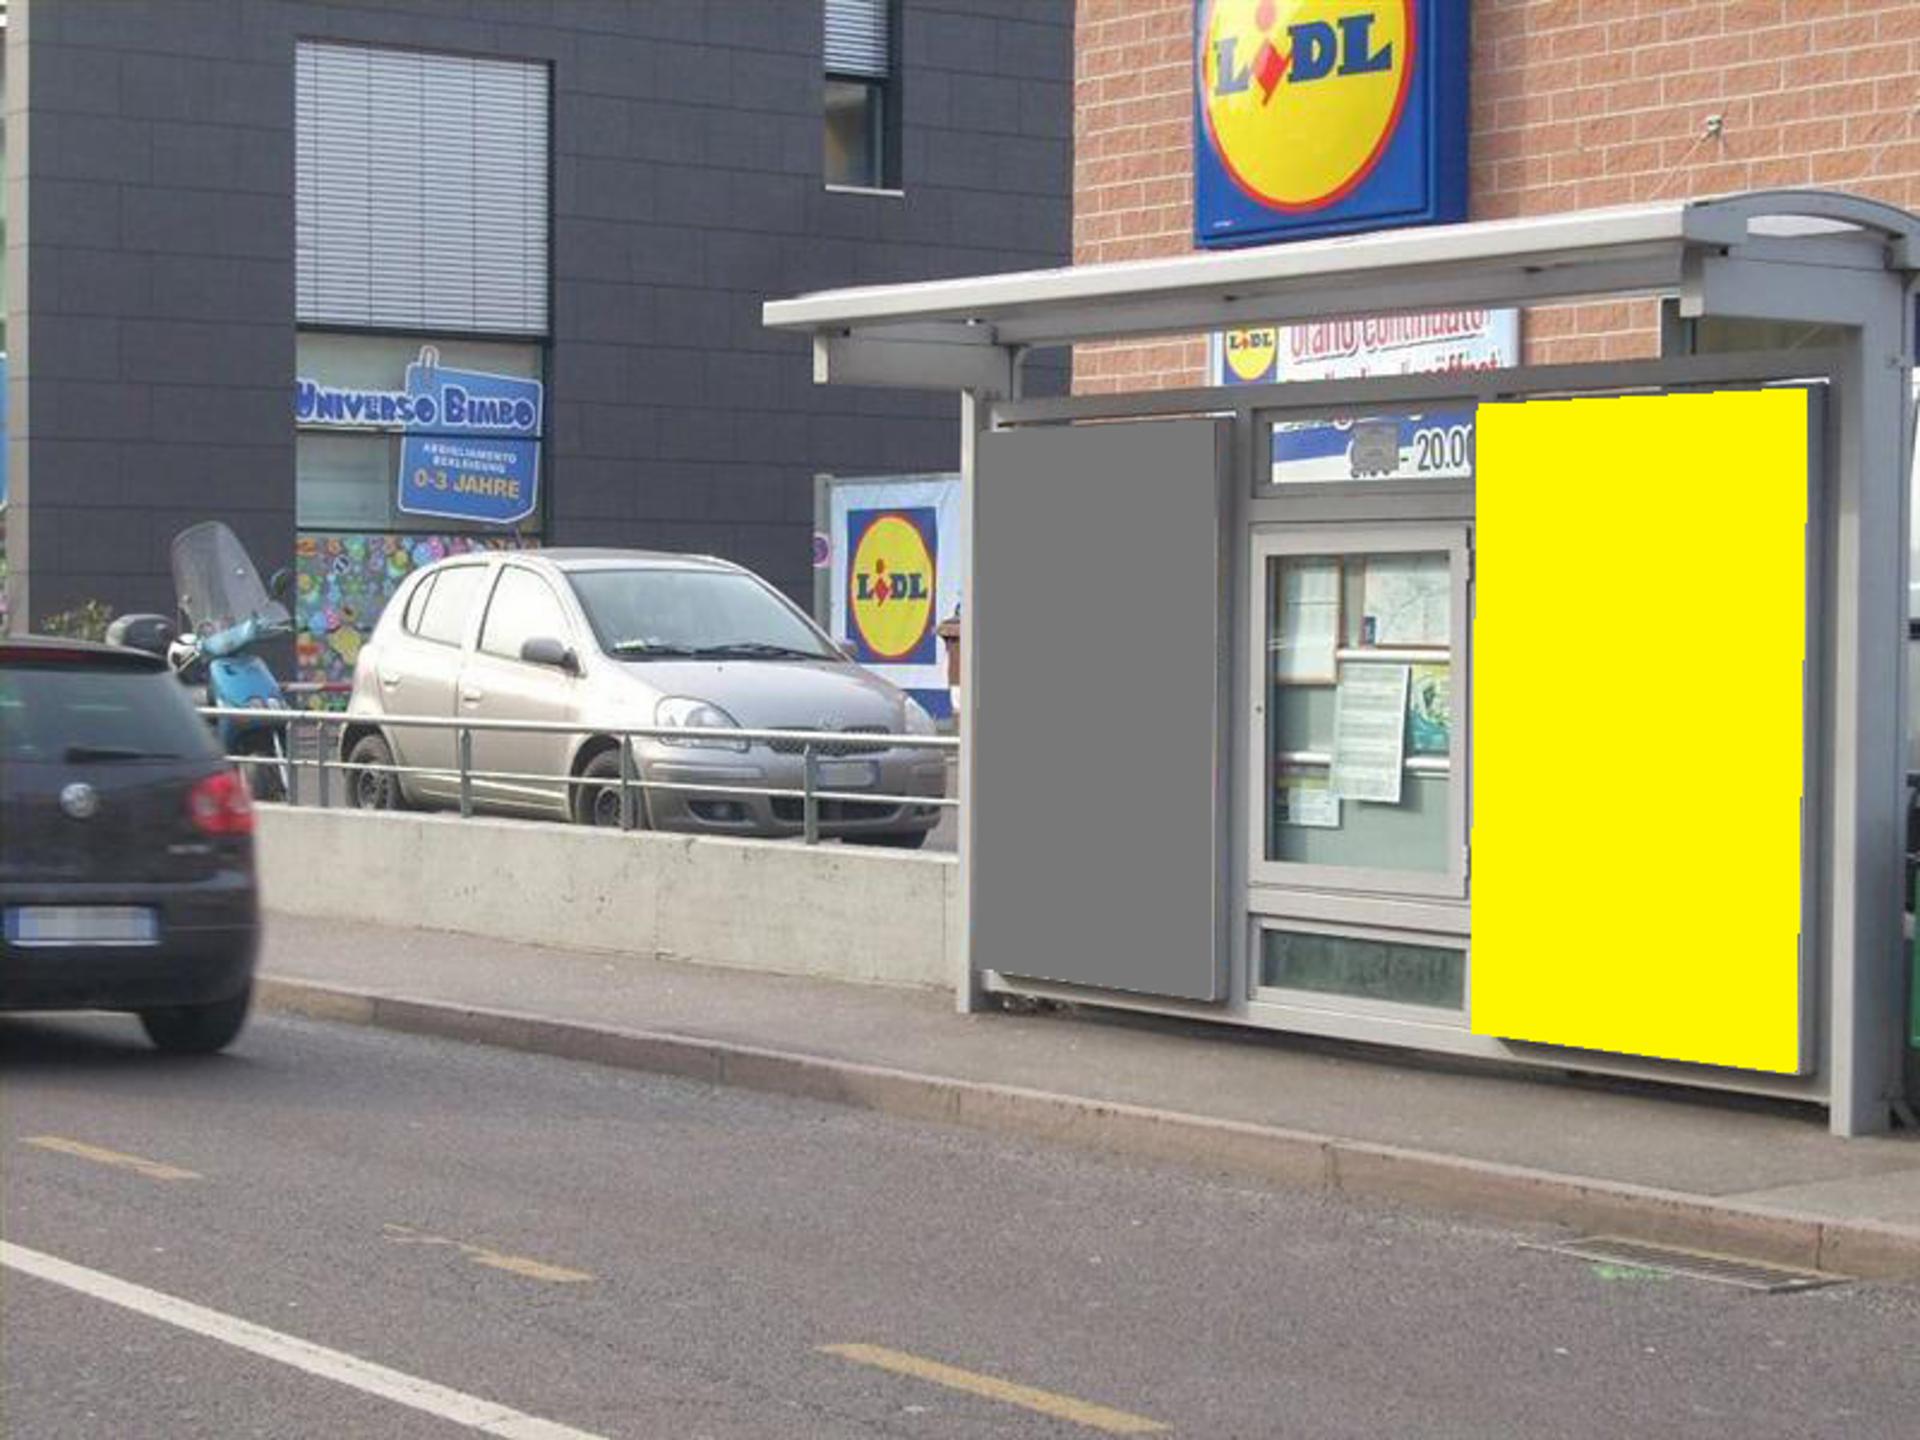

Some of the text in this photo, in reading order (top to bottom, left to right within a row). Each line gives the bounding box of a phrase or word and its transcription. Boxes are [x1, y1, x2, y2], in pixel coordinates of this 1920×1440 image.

[296, 378, 536, 428] UNIVERSO BIMBO
[414, 469, 520, 499] 0-3 JAHRE
